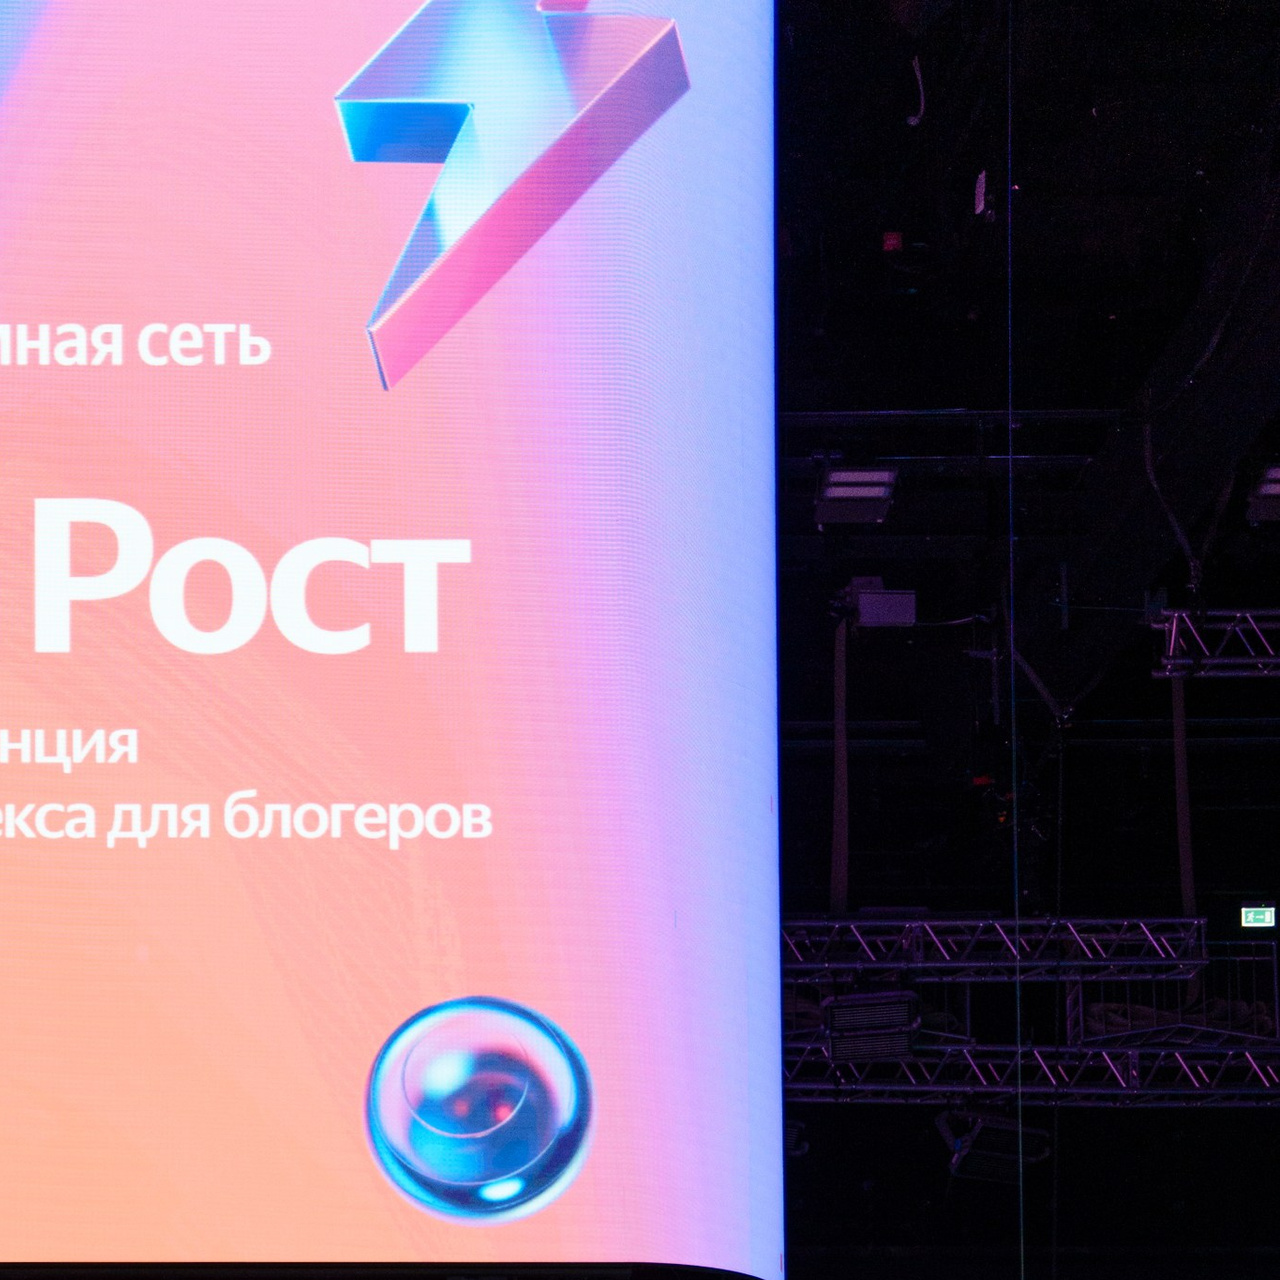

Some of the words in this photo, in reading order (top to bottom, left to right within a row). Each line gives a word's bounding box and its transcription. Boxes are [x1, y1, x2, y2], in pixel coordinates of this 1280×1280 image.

[137, 322, 272, 366] сеть
[34, 497, 472, 655] Рост
[106, 803, 211, 849] для
[223, 788, 493, 851] блогеров
